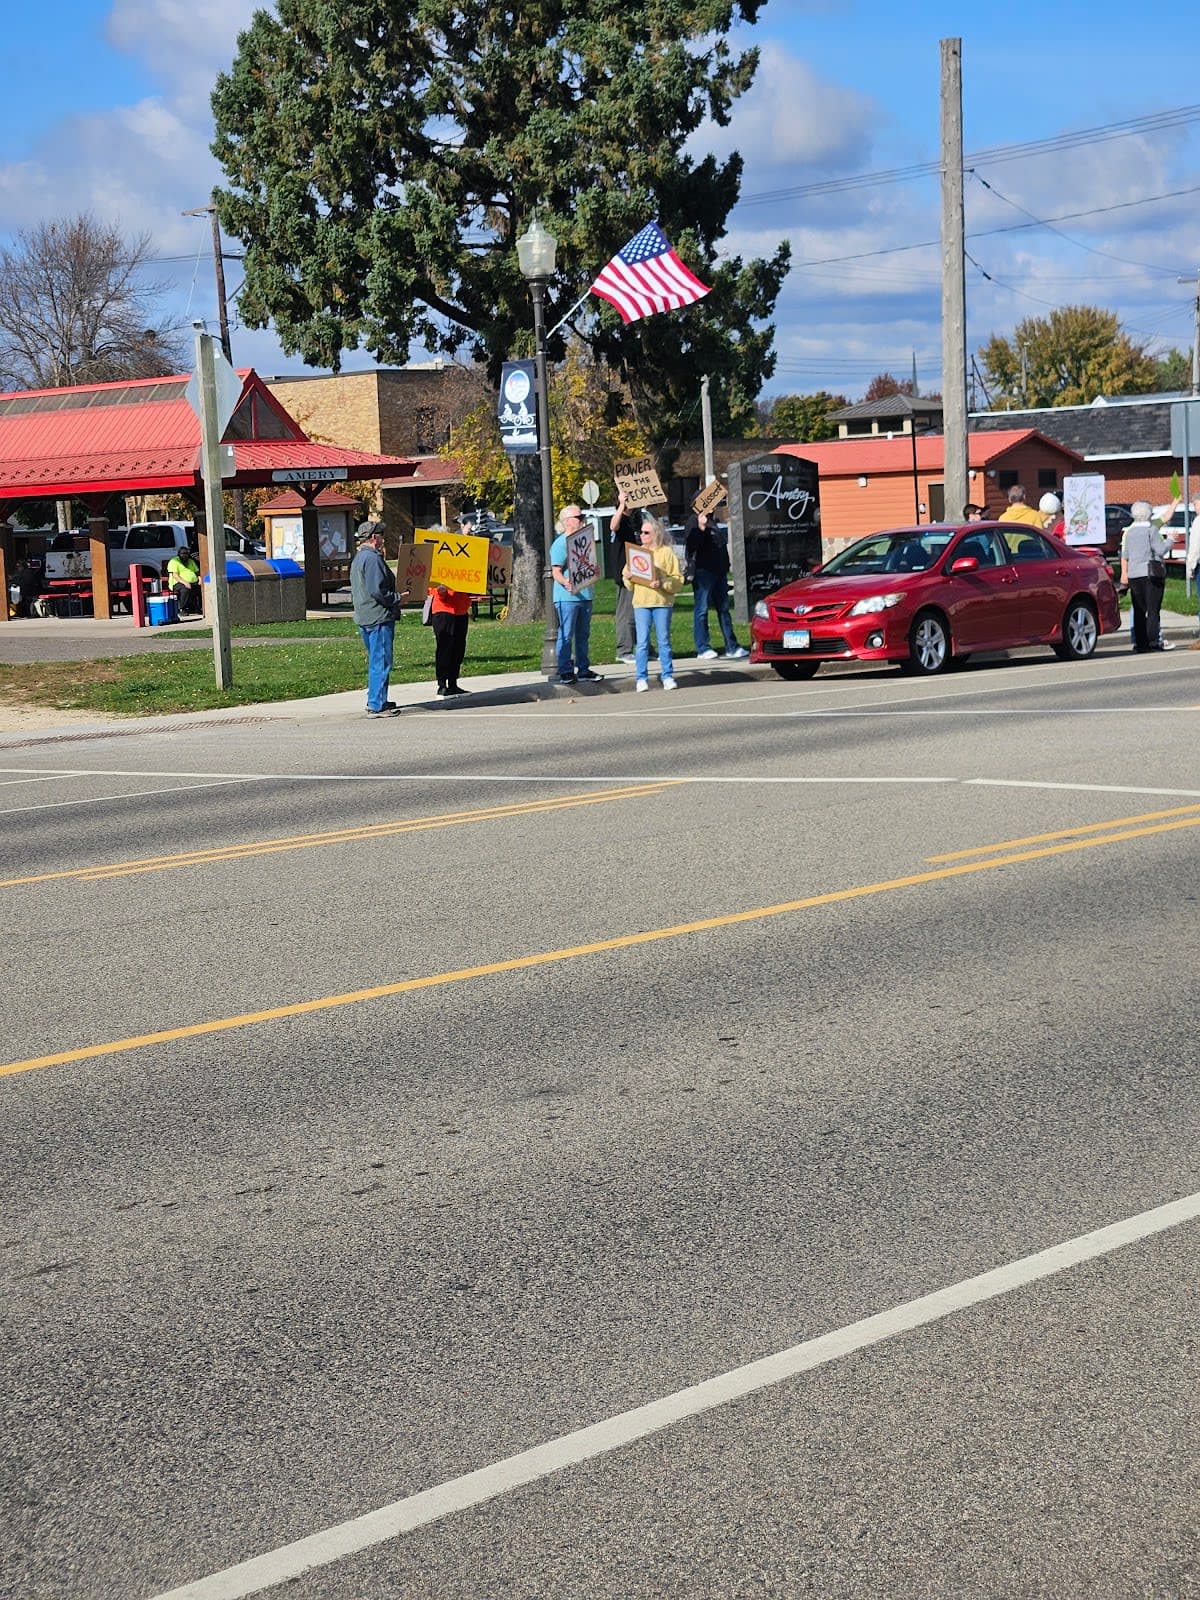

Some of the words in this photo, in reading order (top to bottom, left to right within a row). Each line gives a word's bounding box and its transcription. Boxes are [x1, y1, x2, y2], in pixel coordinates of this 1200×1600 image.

[615, 458, 651, 477] POWER
[285, 470, 337, 480] AMERY
[633, 477, 650, 486] THE
